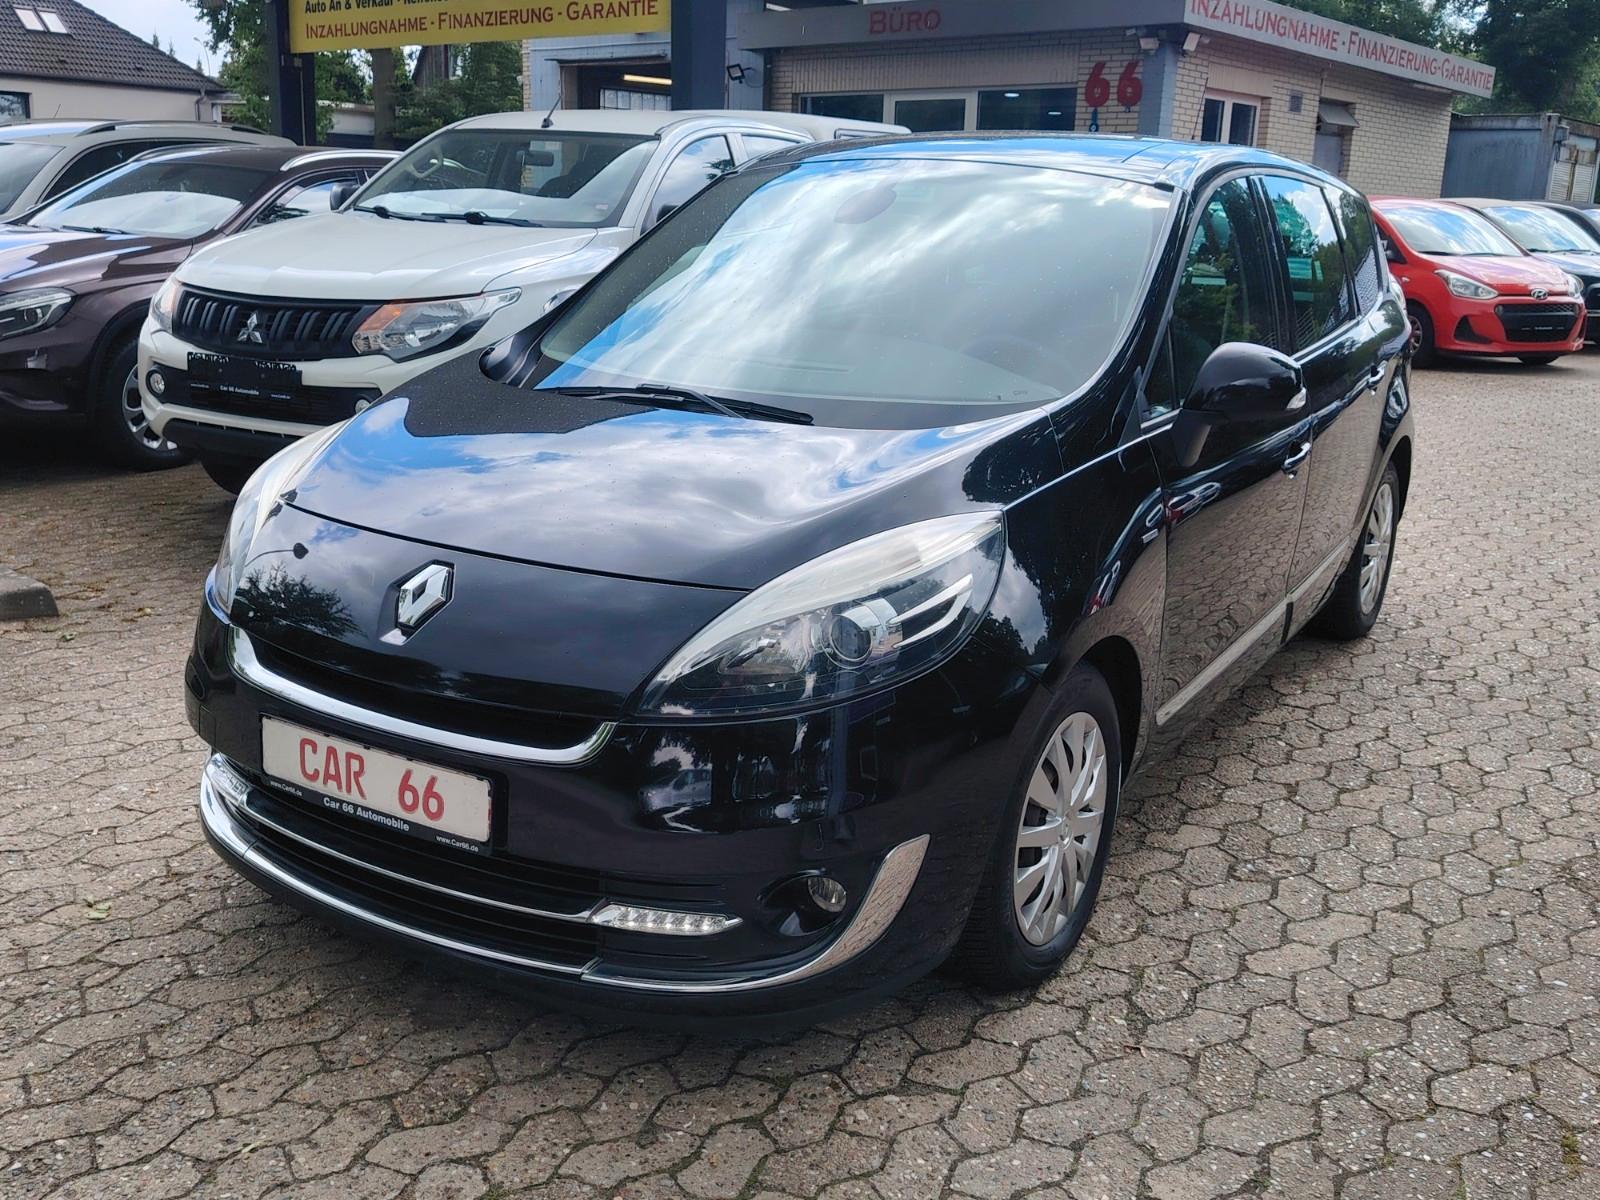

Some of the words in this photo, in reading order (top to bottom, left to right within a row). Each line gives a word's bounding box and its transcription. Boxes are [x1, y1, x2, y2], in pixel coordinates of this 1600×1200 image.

[305, 0, 327, 14] Auto
[329, 0, 342, 11] An
[345, 0, 352, 9] &
[305, 17, 427, 39] INZAHLUNGNAHME
[438, 6, 554, 31] FINANZIERUNG
[566, 0, 659, 21] GARANTIE
[868, 7, 942, 34] BÜRO
[1084, 61, 1143, 108] 66
[299, 737, 367, 801] CAR
[397, 768, 445, 822] 66
[323, 797, 340, 810] Car
[342, 803, 355, 815] 66
[356, 806, 410, 832] Automobile
